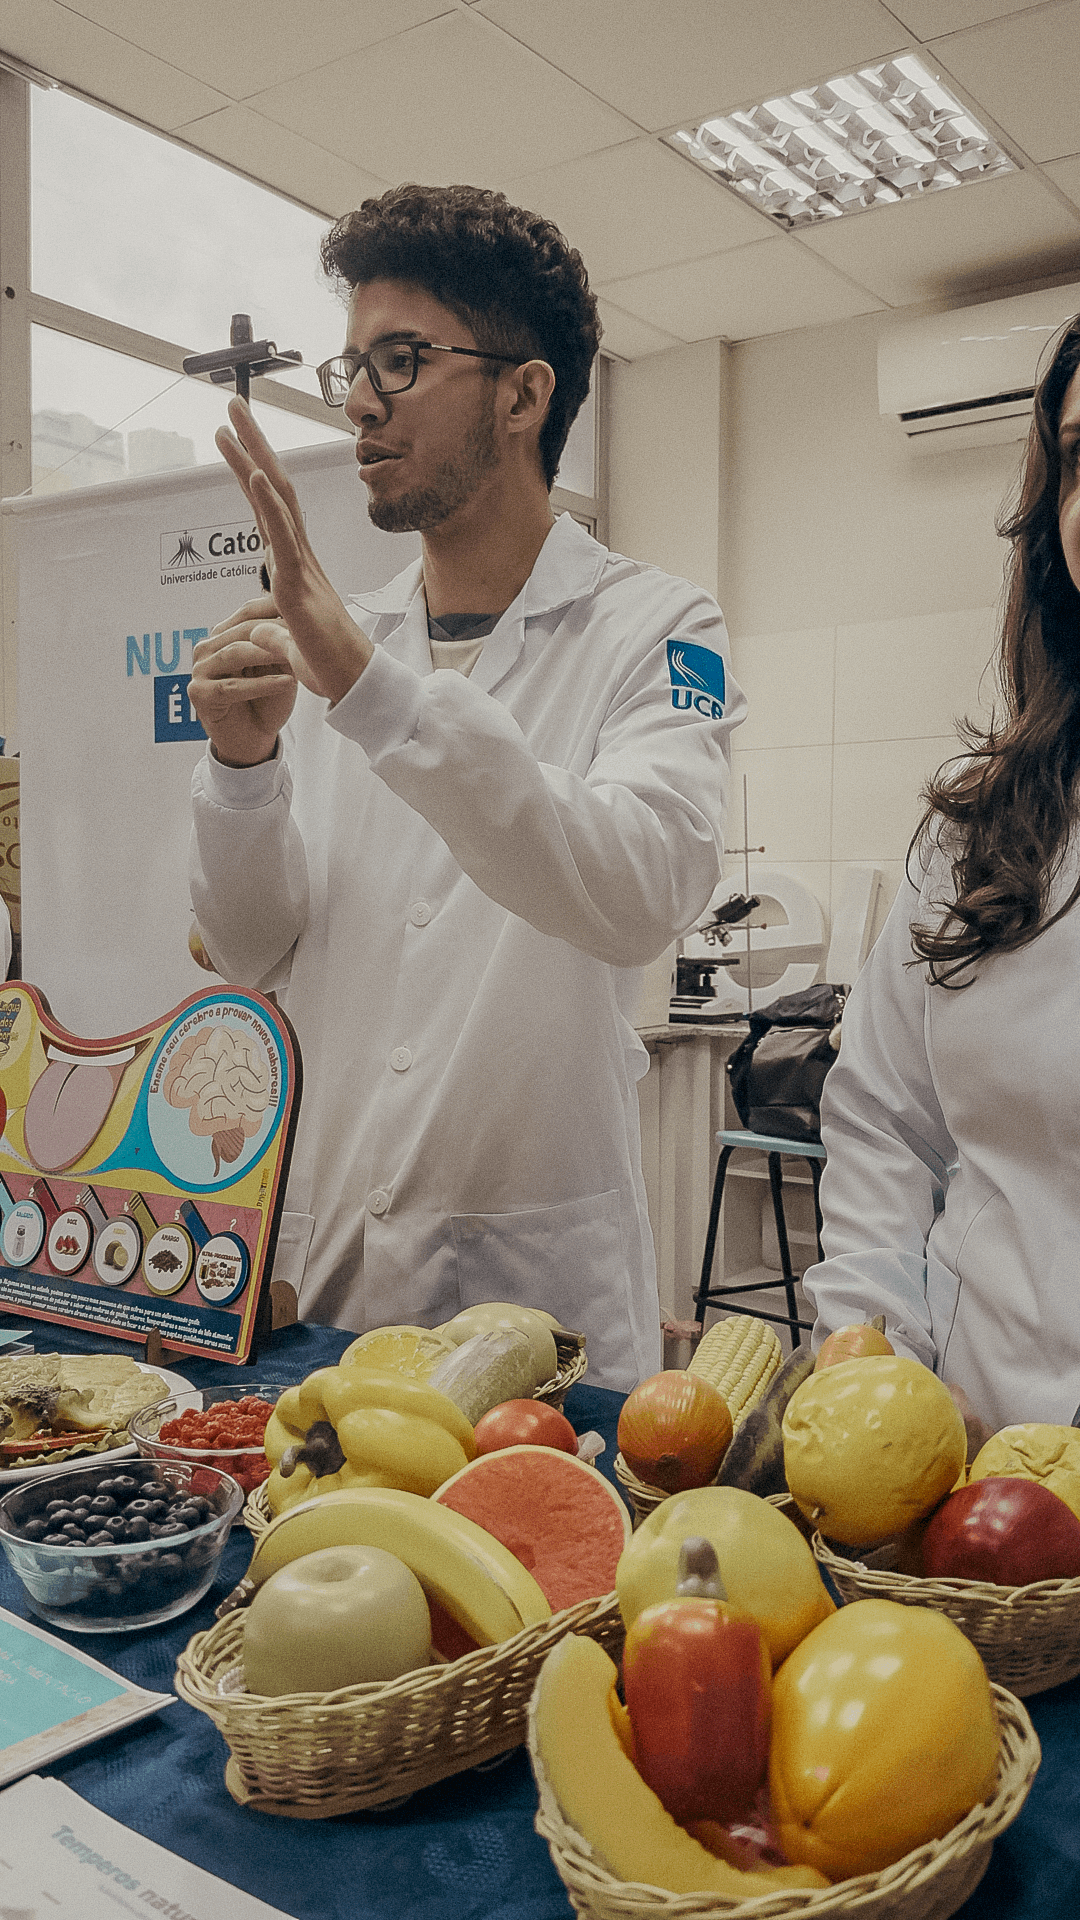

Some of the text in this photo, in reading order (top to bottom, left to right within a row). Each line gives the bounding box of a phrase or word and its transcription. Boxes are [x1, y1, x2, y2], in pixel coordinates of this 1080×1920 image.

[208, 526, 265, 557] Cató
[160, 564, 257, 586] Universidade Católica
[126, 627, 208, 678] NUT
[149, 1056, 168, 1094] Ensine
[179, 1008, 214, 1038] cérebro
[215, 1007, 221, 1017] a
[221, 1006, 253, 1023] provar
[250, 1018, 271, 1046] novos
[28, 1187, 35, 1198] 2
[75, 1194, 82, 1205] 3
[123, 1201, 129, 1213] 4
[174, 1209, 181, 1221] 5
[161, 1233, 180, 1243] AMARGO
[52, 1824, 200, 1920] Temperos natu
